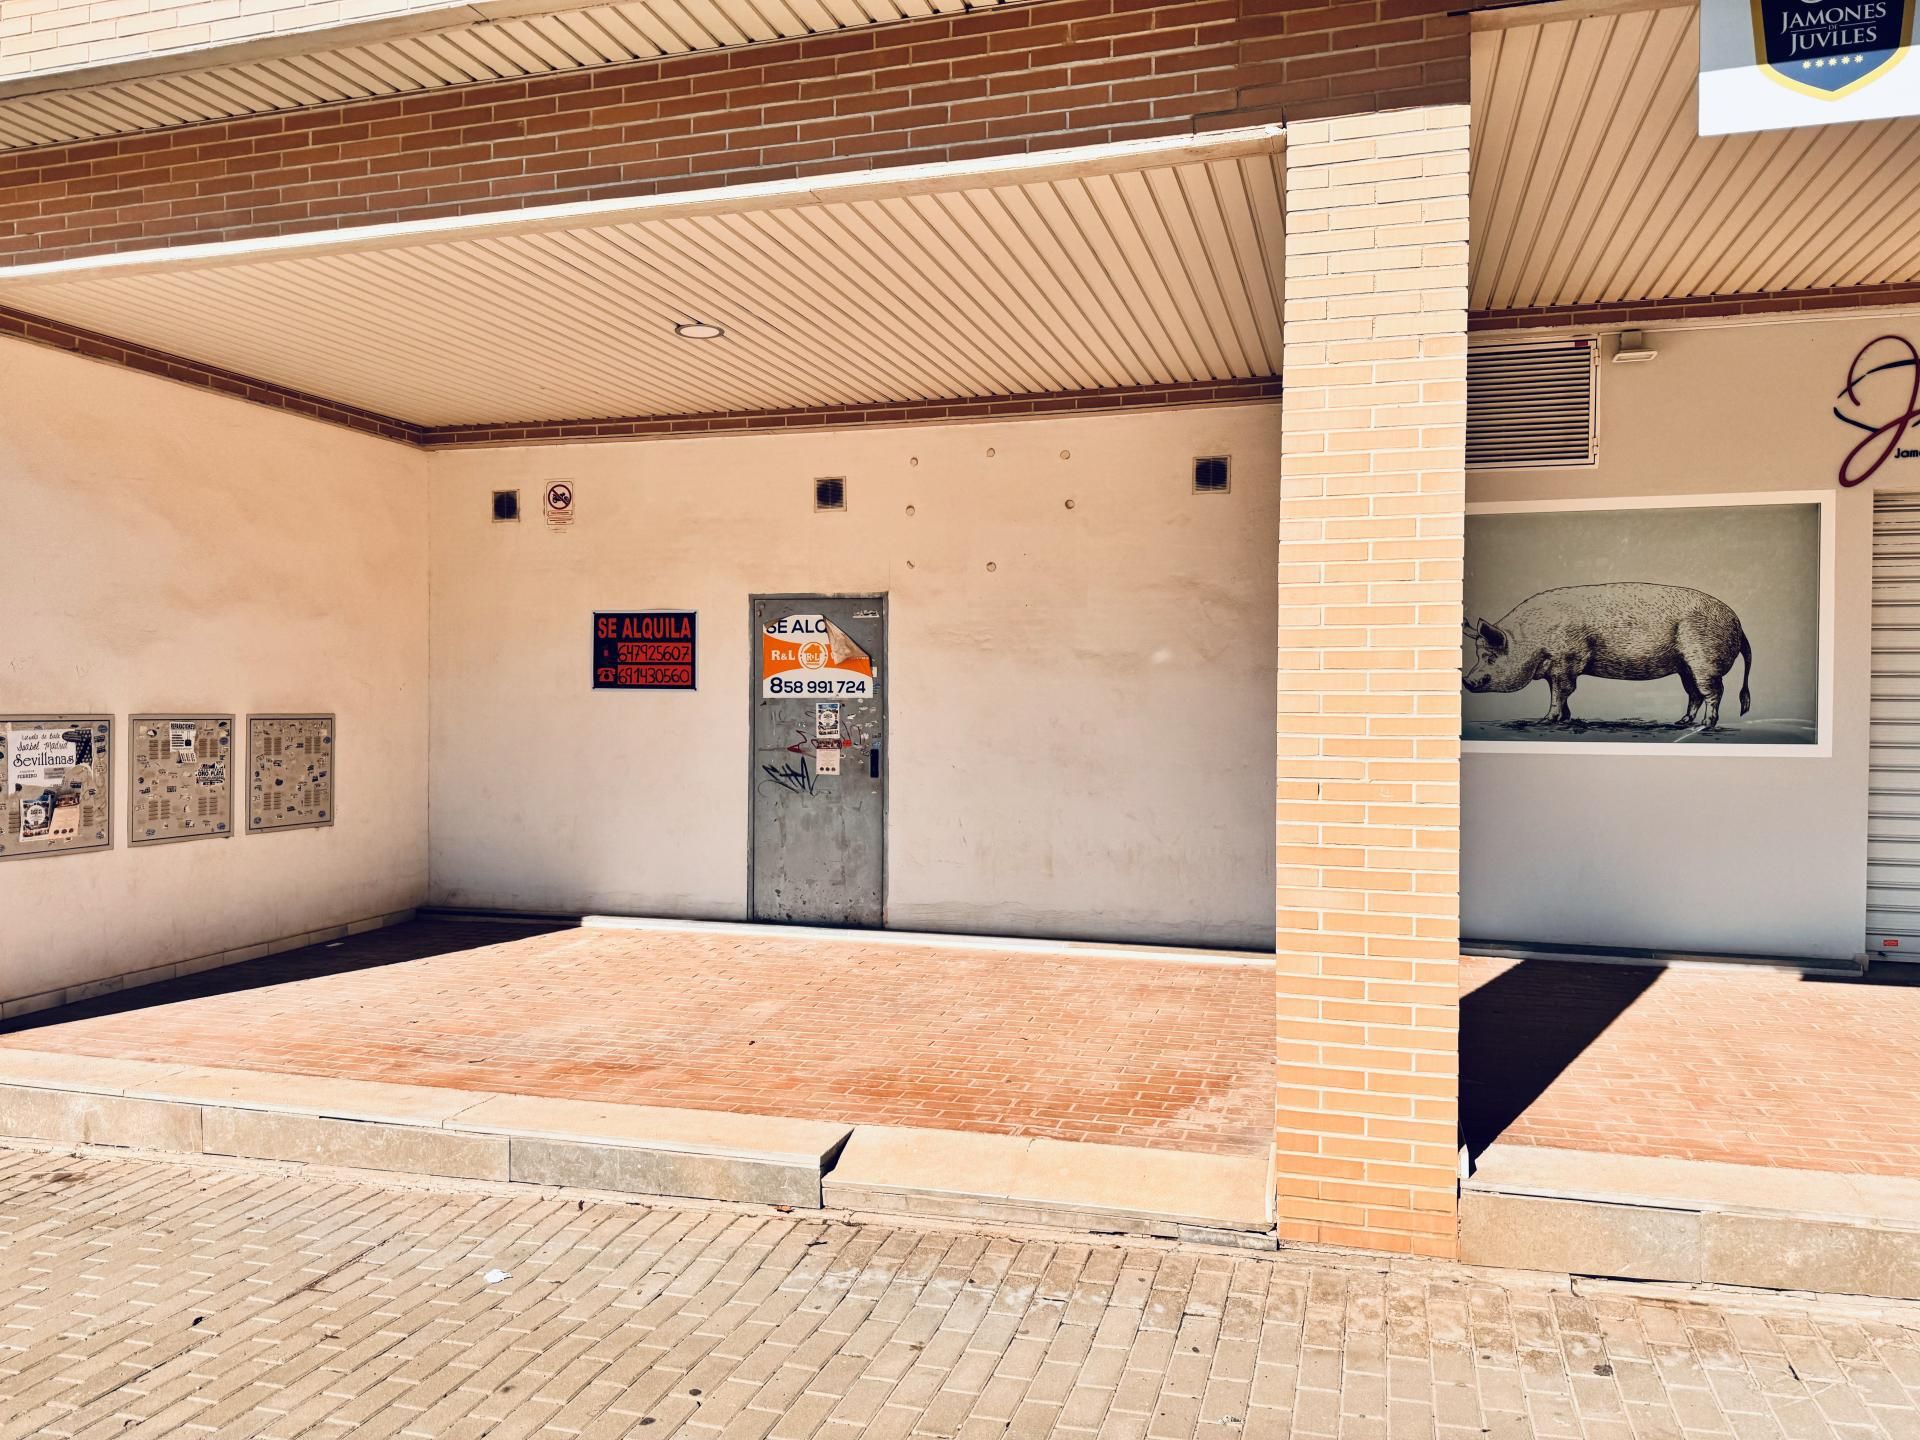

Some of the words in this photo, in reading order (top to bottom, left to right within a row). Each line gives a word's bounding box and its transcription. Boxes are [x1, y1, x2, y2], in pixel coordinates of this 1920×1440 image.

[1781, 2, 1886, 34] JAMONES
[1789, 26, 1877, 56] JUVILES
[1894, 447, 1920, 458] Jam
[597, 617, 617, 639] SE
[622, 617, 691, 640] ALQUILA
[618, 643, 690, 662] 647925607
[771, 649, 796, 661] R&L
[618, 667, 690, 684] 691430560
[770, 677, 803, 694] 858
[807, 681, 833, 694] 991
[837, 681, 866, 694] 724
[13, 751, 75, 768] Sevillanas
